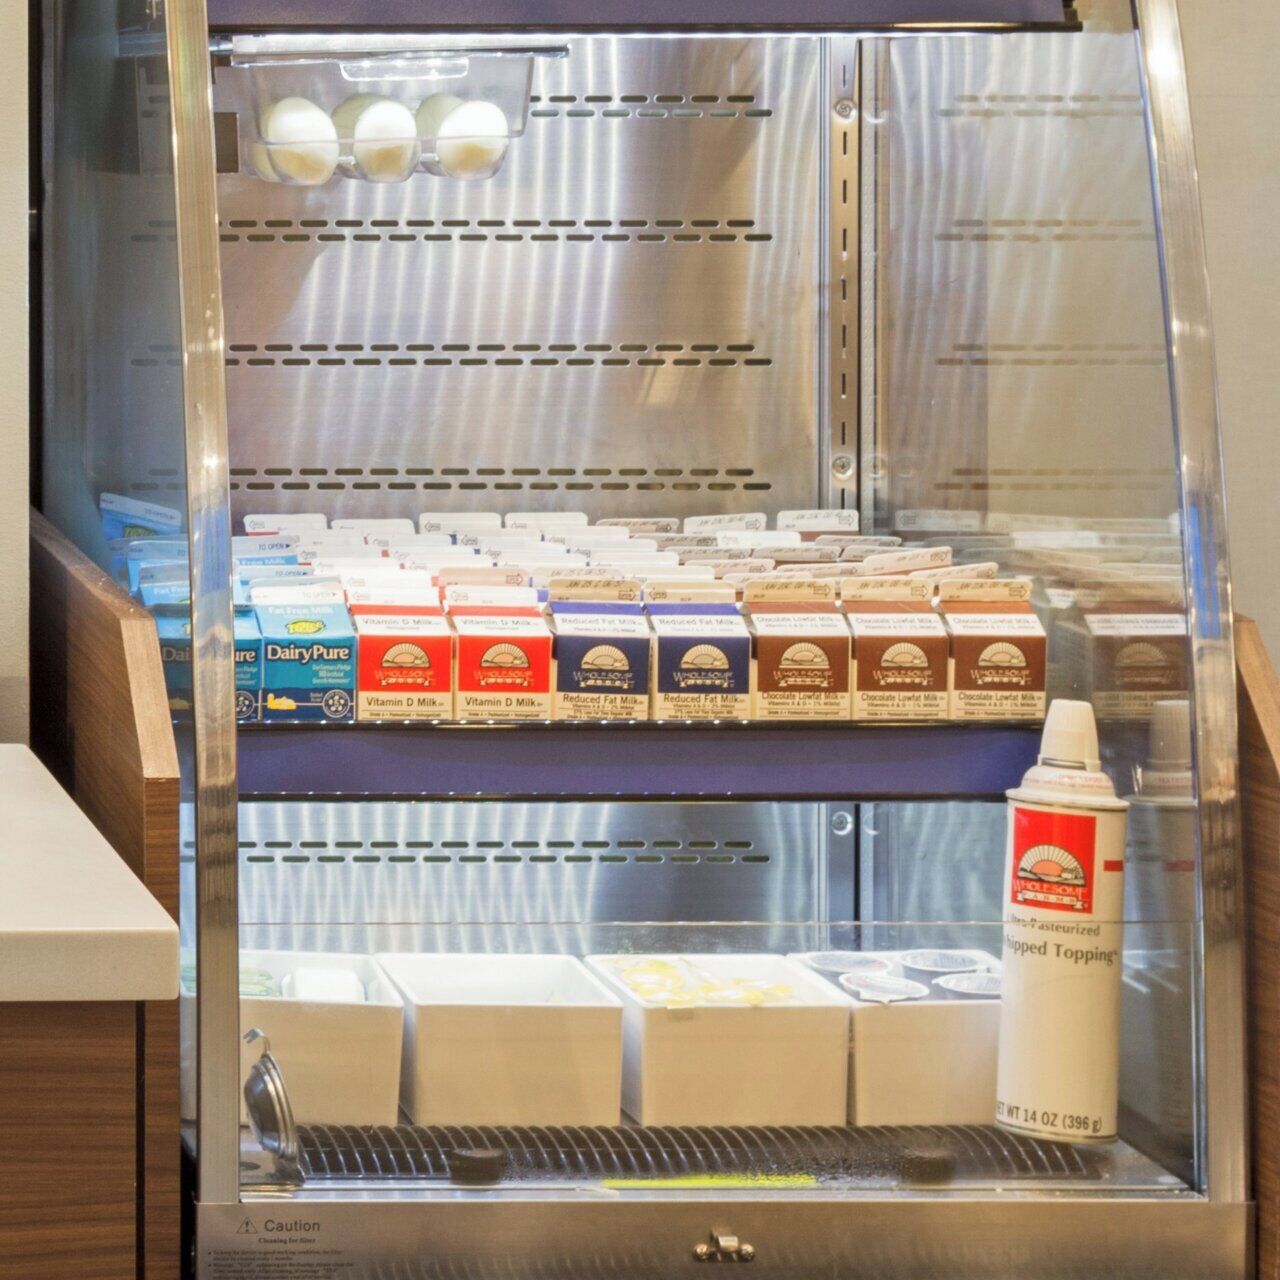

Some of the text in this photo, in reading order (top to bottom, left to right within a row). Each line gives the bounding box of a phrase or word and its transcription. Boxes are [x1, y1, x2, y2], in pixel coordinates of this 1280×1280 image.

[266, 644, 350, 663] DairyPure
[563, 694, 638, 705] Reduced Fat Milk
[663, 693, 739, 704] Reduced Fat Milk
[762, 691, 838, 700] Chocolate Lowfat Milk
[861, 693, 938, 702] Chocolate Lowfat Milk
[958, 692, 1036, 701] Chocolate Lowfat Milk
[366, 696, 438, 707] Vitamin D Milk
[465, 696, 536, 707] Vitamin D Milk
[1053, 943, 1114, 966] Topping
[1007, 1104, 1020, 1120] WT
[1023, 1108, 1037, 1124] 14
[1041, 1112, 1058, 1127] OZ
[1063, 1114, 1089, 1130] (396
[1092, 1117, 1103, 1133] g)
[264, 1219, 321, 1232] Caution
